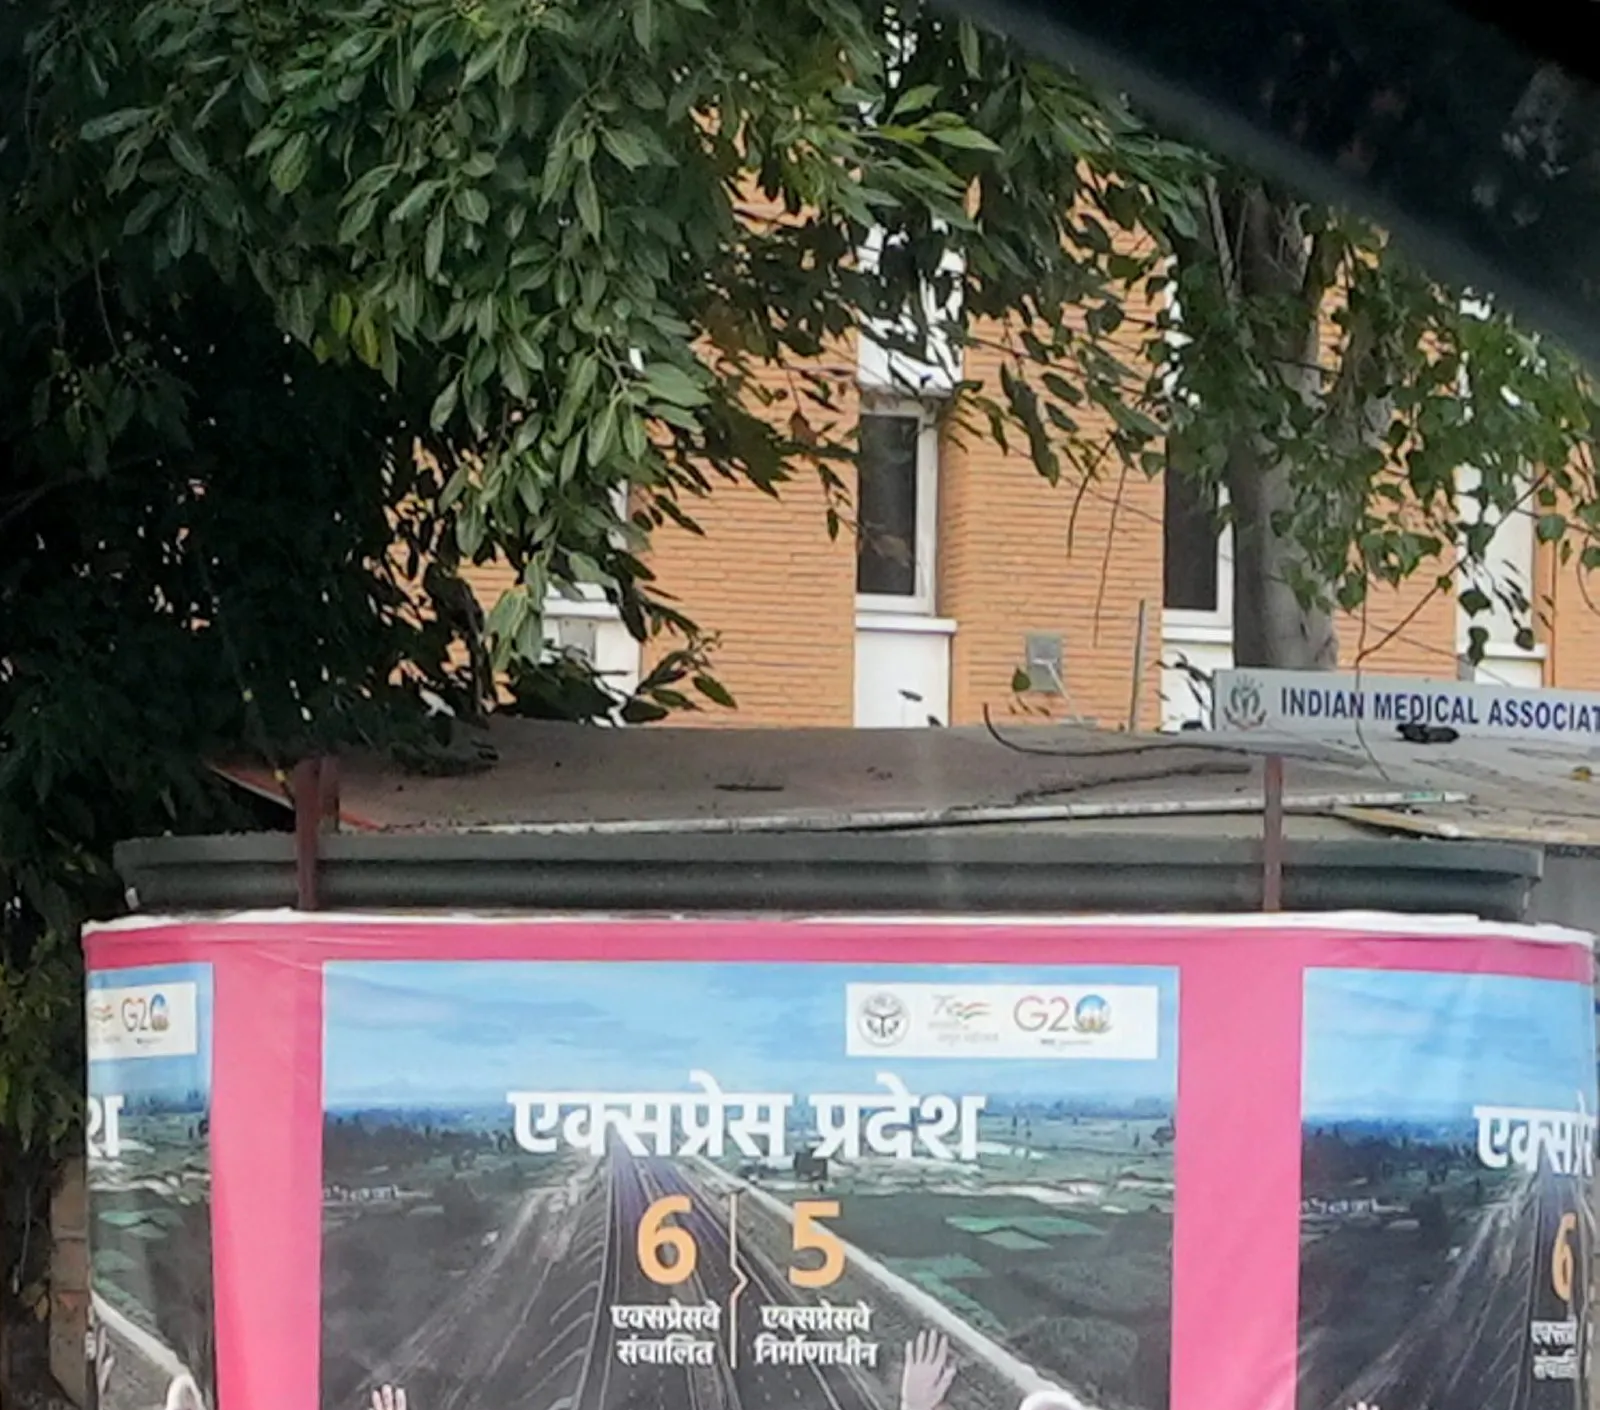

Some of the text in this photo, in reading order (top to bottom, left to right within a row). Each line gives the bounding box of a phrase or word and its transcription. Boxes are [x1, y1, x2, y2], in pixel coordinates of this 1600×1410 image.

[1281, 686, 1365, 719] INDIAN
[1374, 692, 1479, 724] MEDICAL
[506, 1070, 987, 1160] एक्सप्रेस प्रदेश
[636, 1195, 697, 1285] 6
[788, 1200, 846, 1288] 5
[609, 1299, 722, 1333] एक्सप्रेसवे
[759, 1299, 873, 1333] एक्सप्रेसवे
[616, 1331, 714, 1367] संचालित
[753, 1332, 879, 1368] निर्माणाधीन
